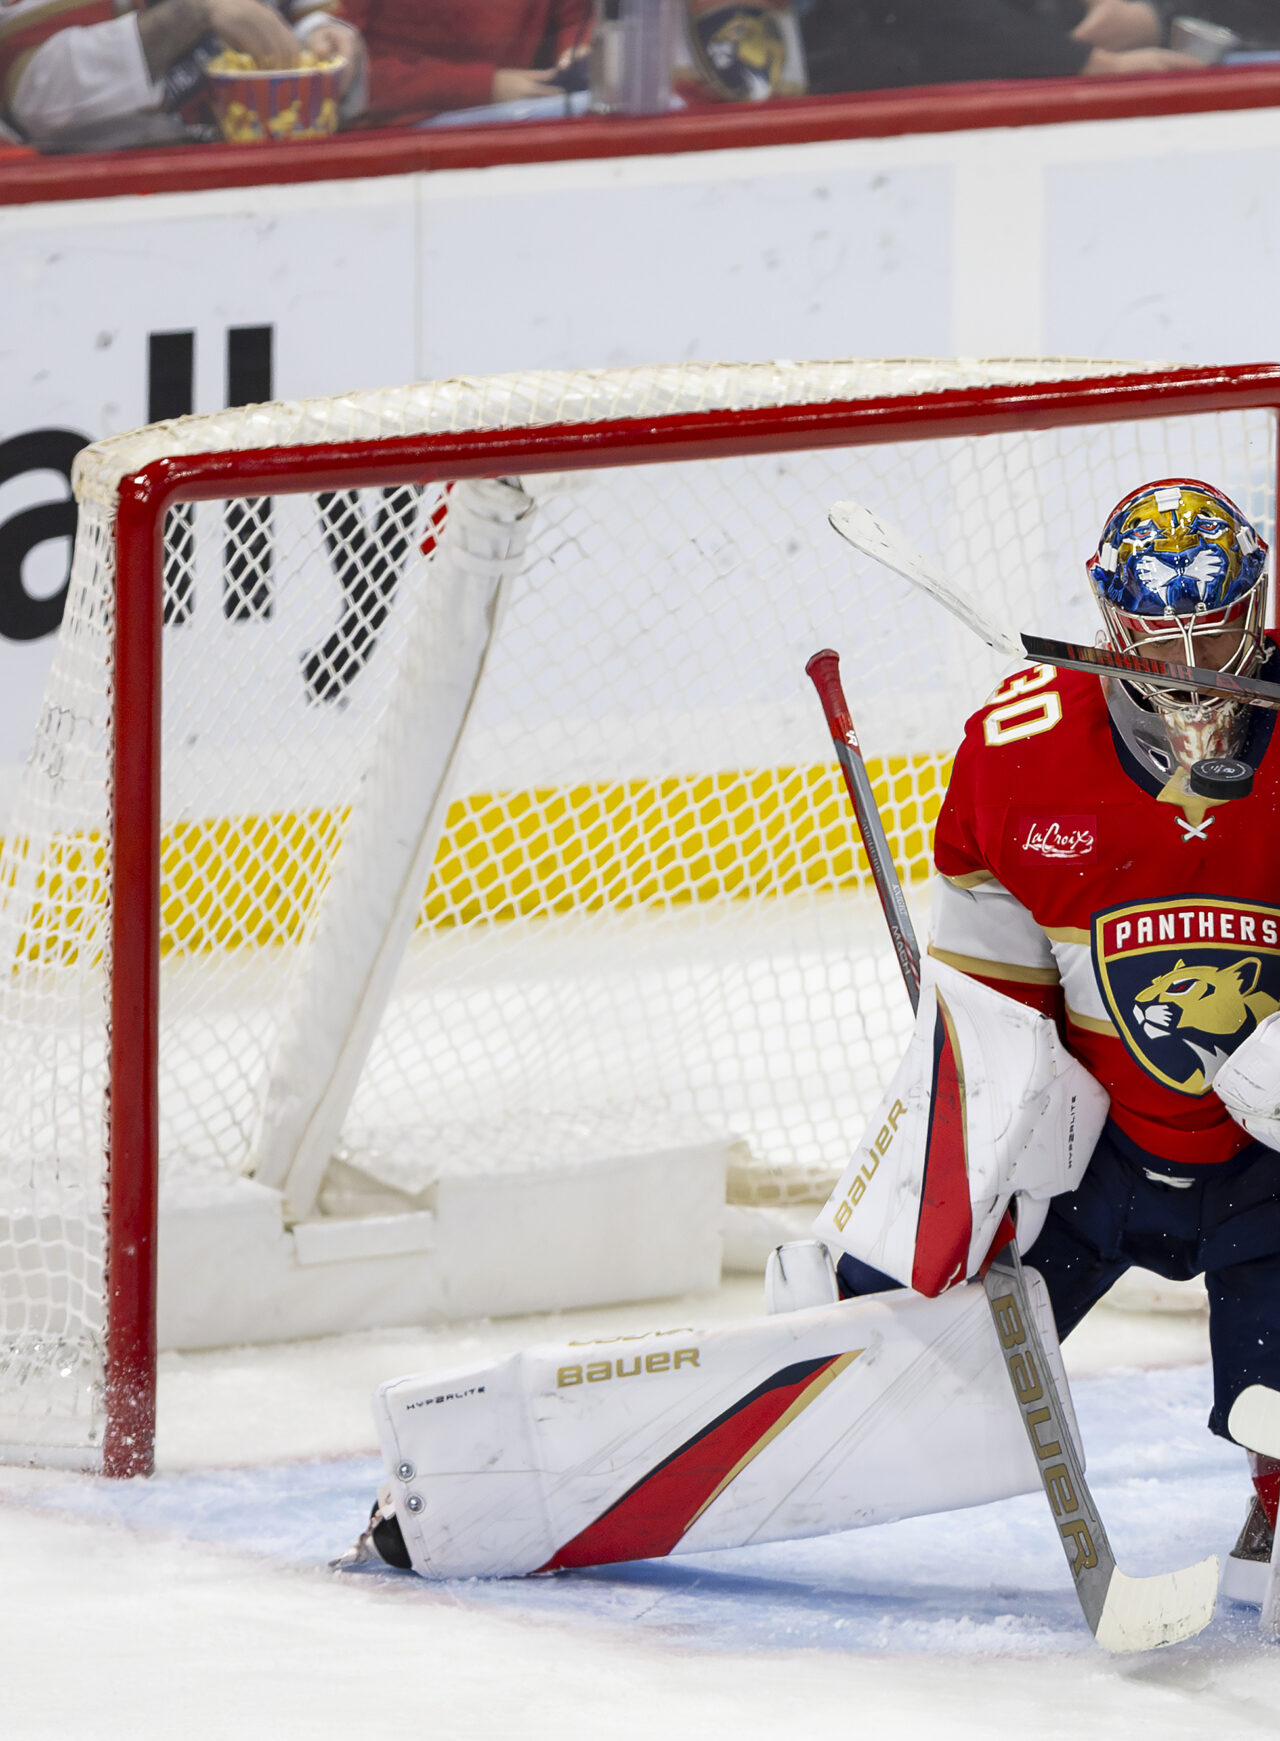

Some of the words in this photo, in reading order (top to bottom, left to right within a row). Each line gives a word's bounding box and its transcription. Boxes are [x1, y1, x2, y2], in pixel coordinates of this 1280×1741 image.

[983, 663, 1063, 747] 30
[1022, 822, 1094, 857] LaCroix
[891, 925, 912, 976] MACH
[1115, 911, 1278, 950] PANTHERS
